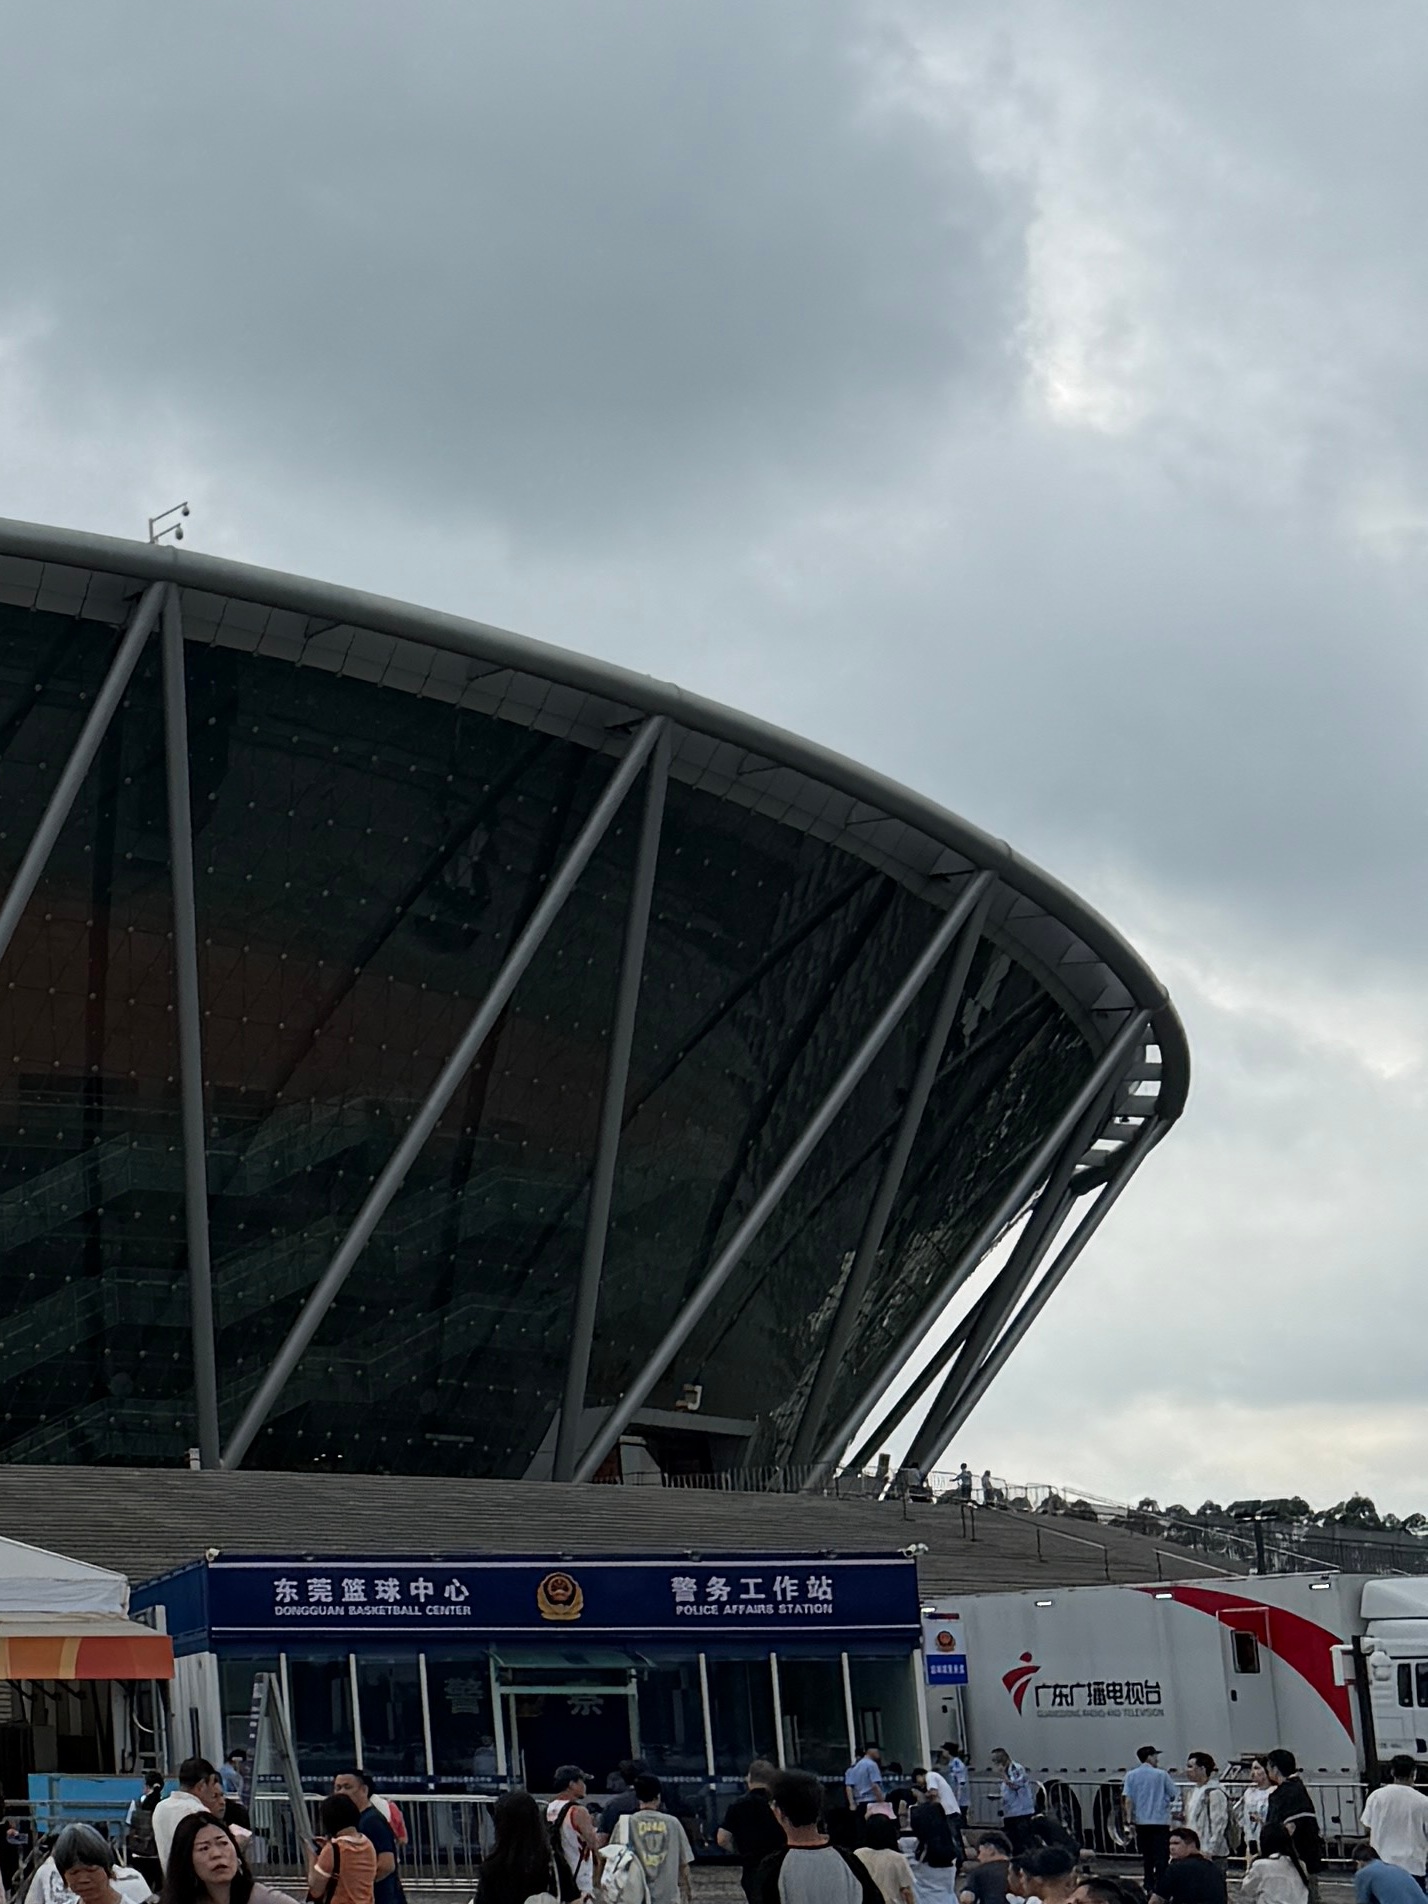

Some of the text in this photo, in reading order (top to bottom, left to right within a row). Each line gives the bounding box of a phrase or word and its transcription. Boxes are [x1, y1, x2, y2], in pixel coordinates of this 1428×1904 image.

[274, 1577, 469, 1603] 东莞篮球中心
[670, 1576, 833, 1603] 警务工作站
[274, 1606, 472, 1616] DONGGUAN BASKETBALL CENTER
[676, 1604, 833, 1615] POLICE AFFAIRS STATION
[1035, 1679, 1162, 1708] 广东广播电视台
